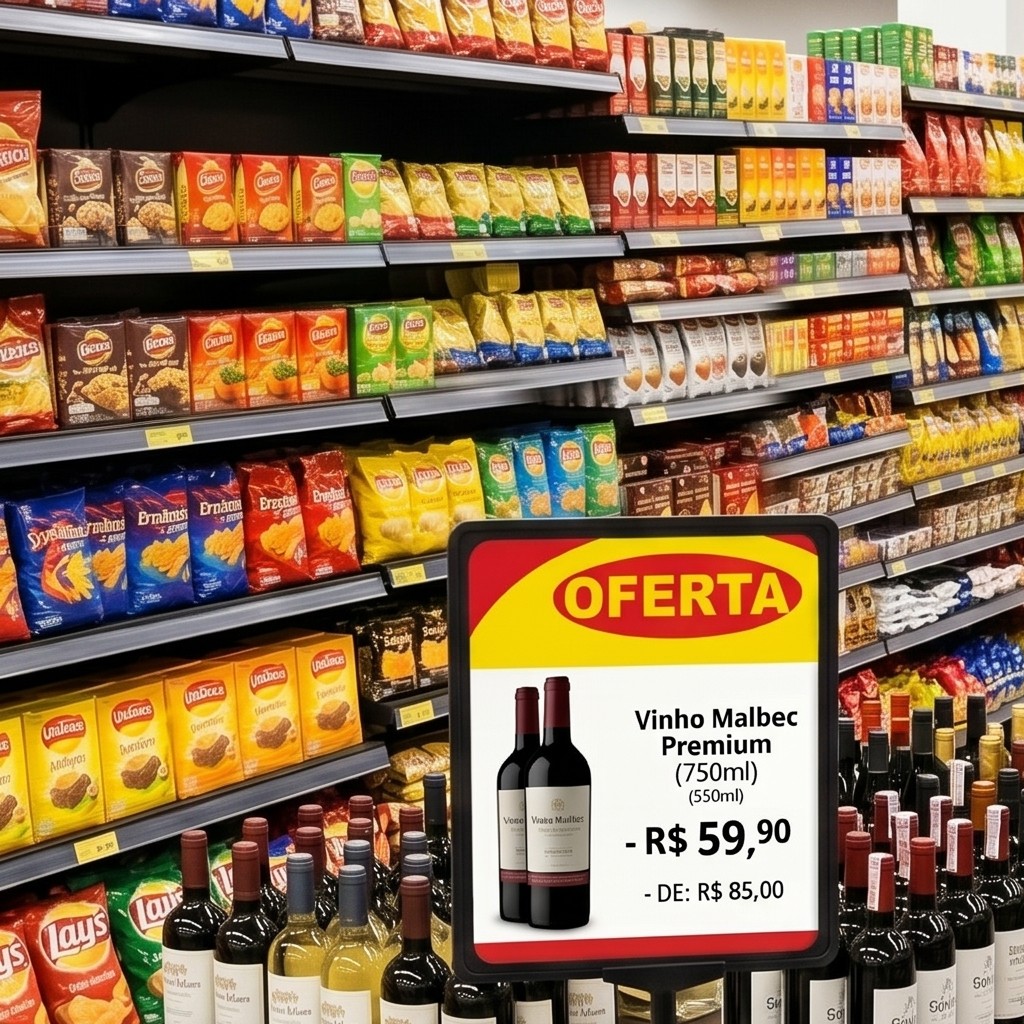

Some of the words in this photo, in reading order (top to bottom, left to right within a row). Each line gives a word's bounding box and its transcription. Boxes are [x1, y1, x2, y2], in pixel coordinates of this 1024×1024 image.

[563, 572, 790, 619] OFERTA
[634, 708, 705, 731] Vinho
[712, 706, 798, 728] Malbec
[661, 733, 772, 756] Premium
[675, 761, 758, 785] (750ml)
[689, 788, 744, 806] (550ml)
[646, 823, 688, 857] R$
[698, 818, 791, 860] 59,90
[658, 883, 690, 903] DE:
[698, 880, 723, 903] R$
[728, 880, 784, 903] 85,00
